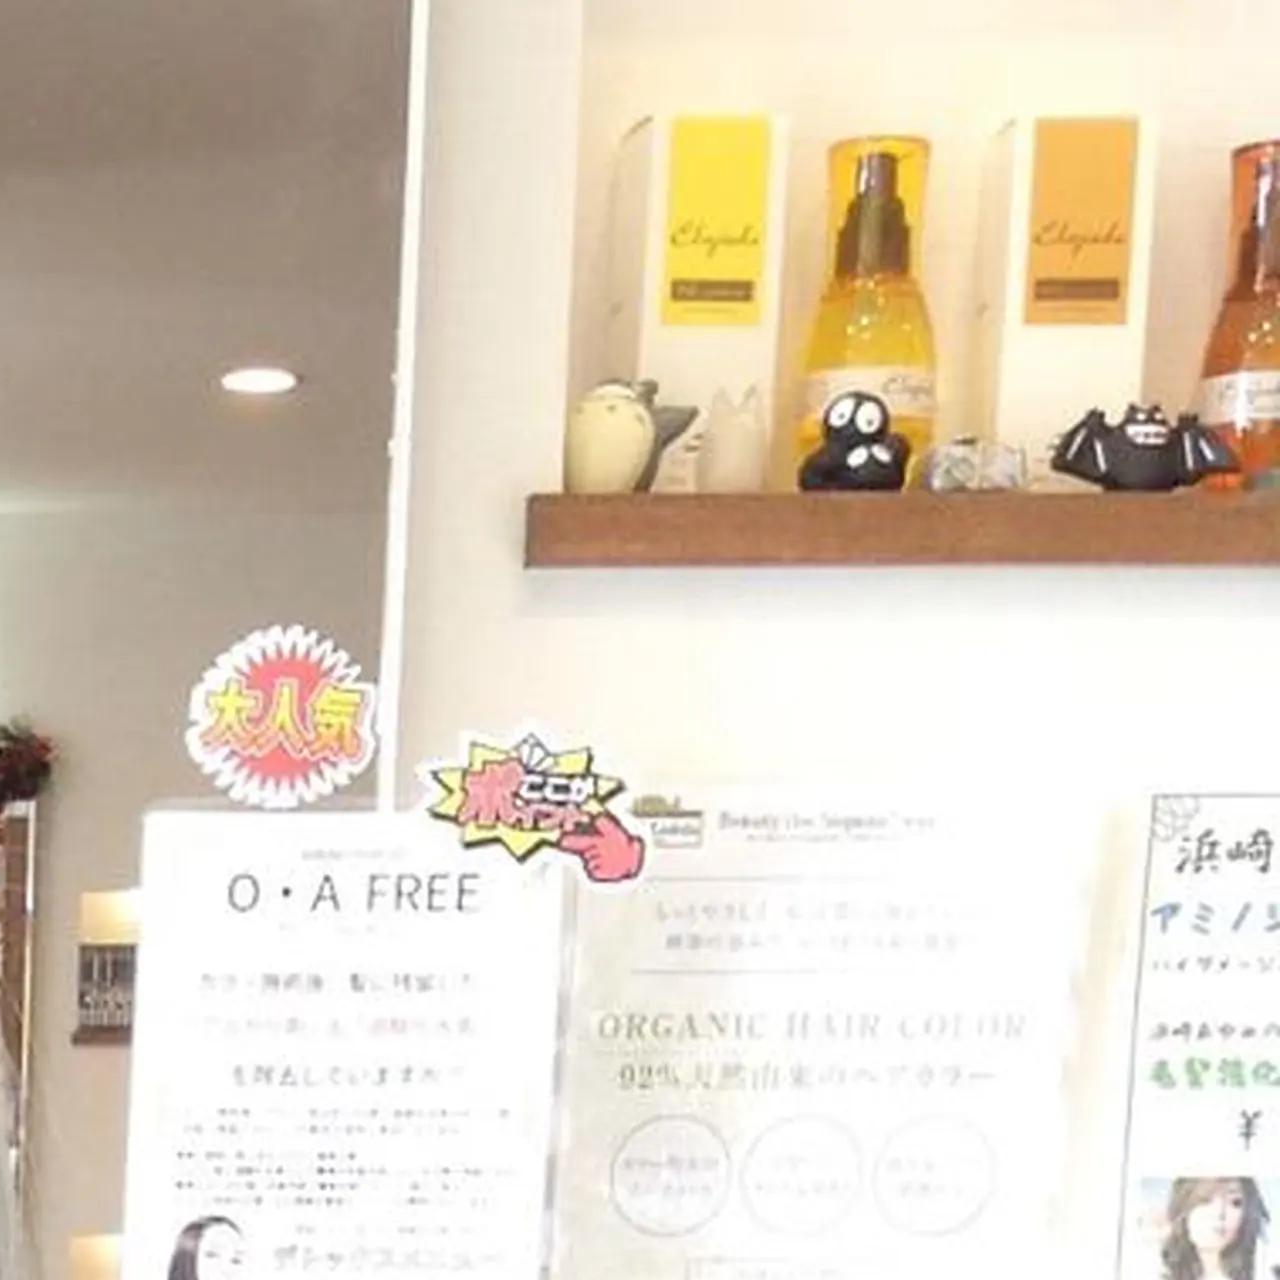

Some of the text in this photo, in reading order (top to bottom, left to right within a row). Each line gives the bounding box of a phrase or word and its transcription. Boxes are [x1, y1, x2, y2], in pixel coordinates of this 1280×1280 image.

[203, 678, 365, 762] 大人気
[1175, 827, 1274, 875] 浜崎
[365, 873, 483, 914] FREE
[596, 1012, 766, 1043] ORGANIC
[785, 1012, 882, 1042] HAIR
